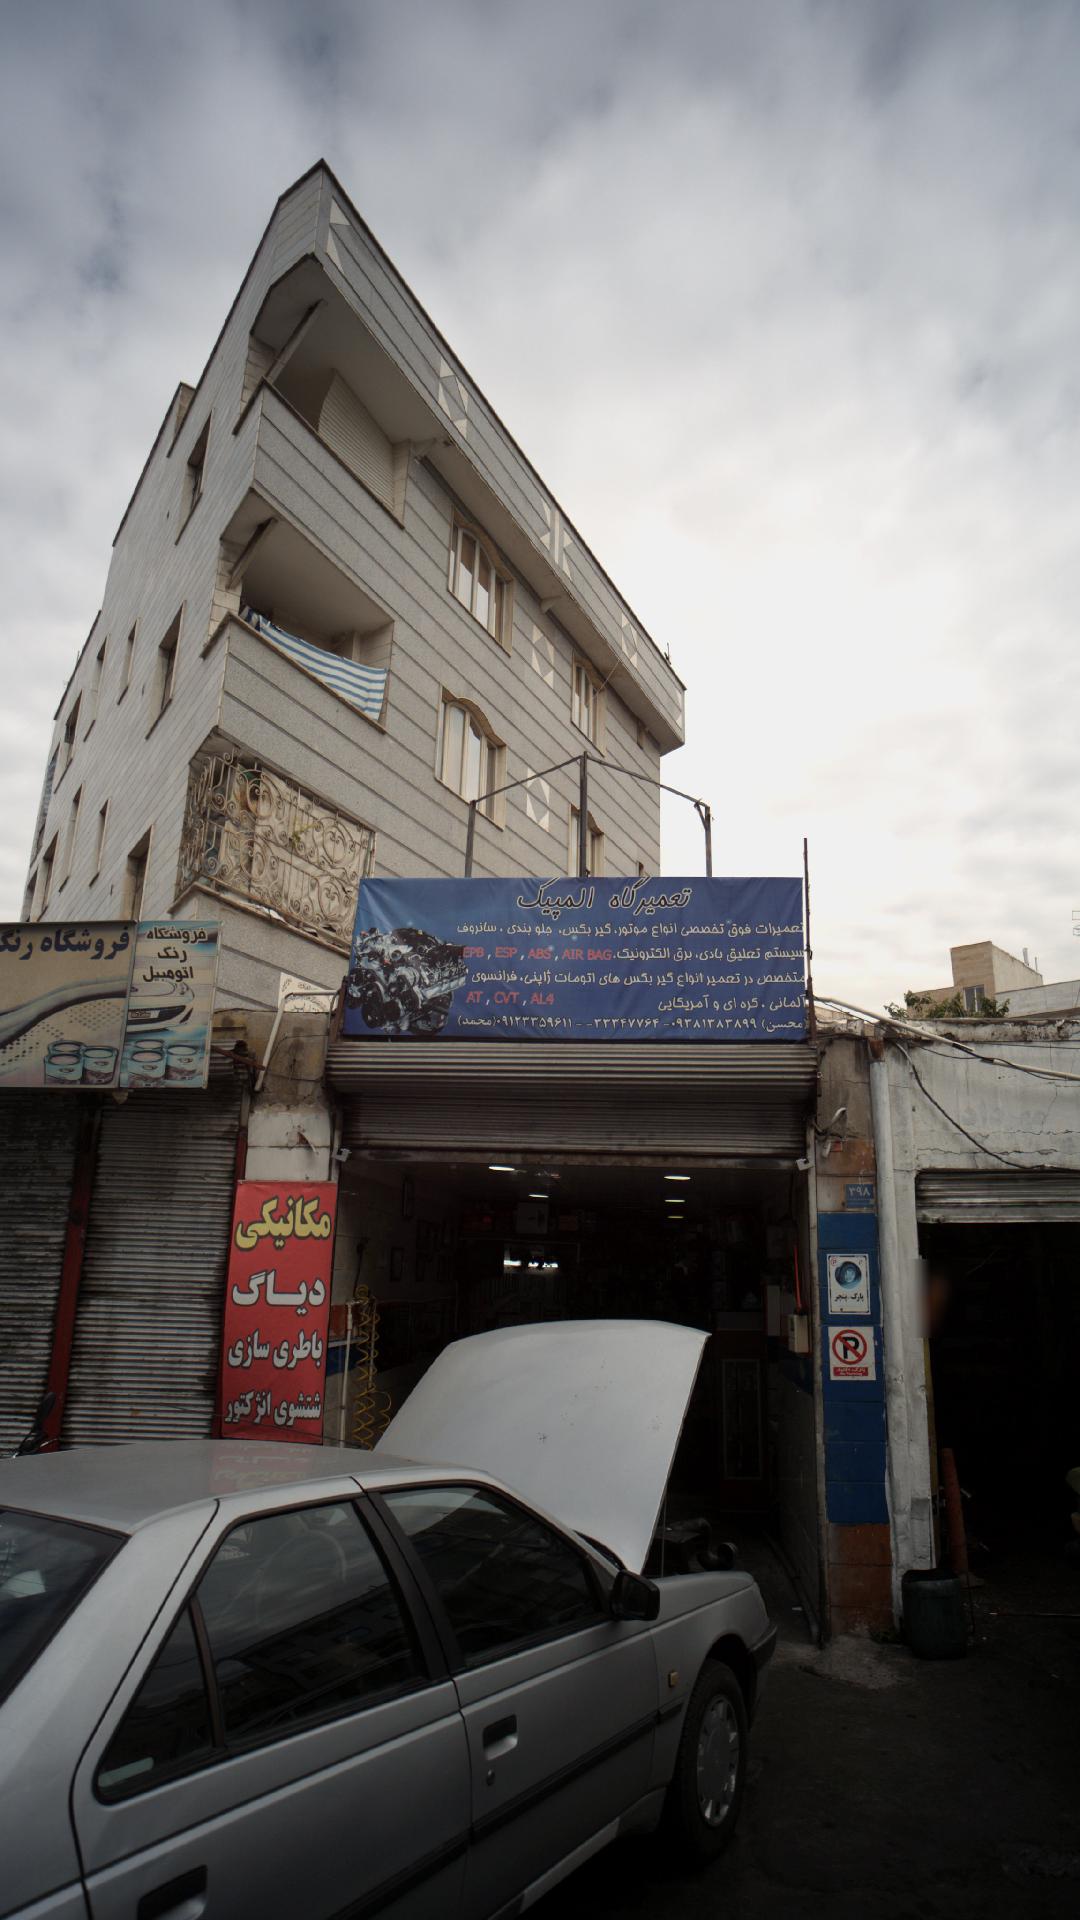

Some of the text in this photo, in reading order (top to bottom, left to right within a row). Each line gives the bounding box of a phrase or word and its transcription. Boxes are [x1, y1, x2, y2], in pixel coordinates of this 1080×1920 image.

[516, 877, 692, 920] تعمیرگاه المپیک
[507, 922, 532, 936] بندی
[535, 922, 552, 936] جلو
[651, 923, 677, 938] انواع
[680, 923, 725, 937] تخصصی
[728, 924, 752, 938] فوق
[755, 922, 803, 936] تعمیرات
[40, 926, 130, 960] فروشگاه
[528, 948, 552, 960] ABS
[562, 948, 584, 960] AIR
[587, 948, 612, 961] BAG
[673, 948, 692, 962] برق
[726, 947, 760, 962] تعلیق
[764, 947, 805, 961] سیستم
[142, 965, 194, 983] اتومبیل
[471, 970, 518, 983] فرانسوی
[554, 972, 595, 985] اتومات
[598, 973, 621, 986] های
[676, 972, 703, 987] انواع
[706, 973, 741, 986] تعمیر
[744, 975, 754, 986] در
[757, 972, 805, 985] متخصص
[466, 991, 484, 1004] AT
[494, 991, 520, 1004] CVT
[658, 993, 807, 1011] آلمانی کره ای و آمریکایی
[234, 1195, 332, 1250] مکانیکی
[231, 1269, 326, 1316] دیاگ
[227, 1327, 323, 1369] باطری سازی
